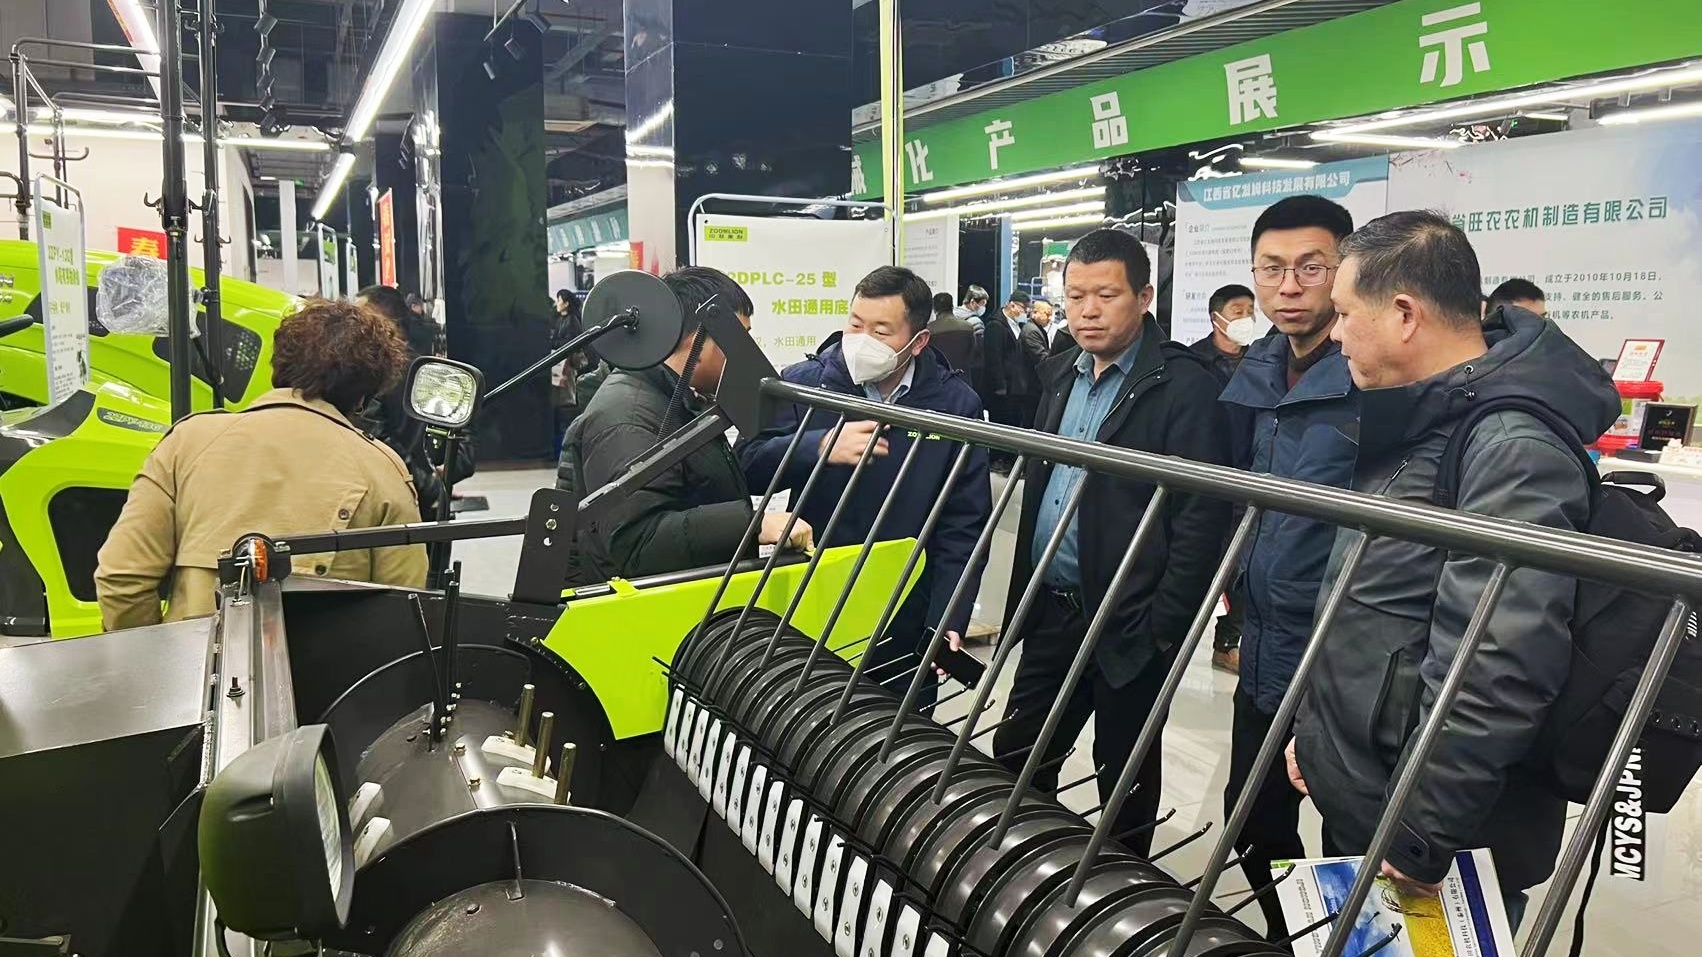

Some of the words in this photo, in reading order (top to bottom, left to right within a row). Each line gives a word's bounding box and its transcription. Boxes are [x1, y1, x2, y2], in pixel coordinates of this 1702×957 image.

[822, 271, 837, 287] 型
[771, 299, 849, 315] 水田通用底
[907, 430, 941, 441] ZOION
